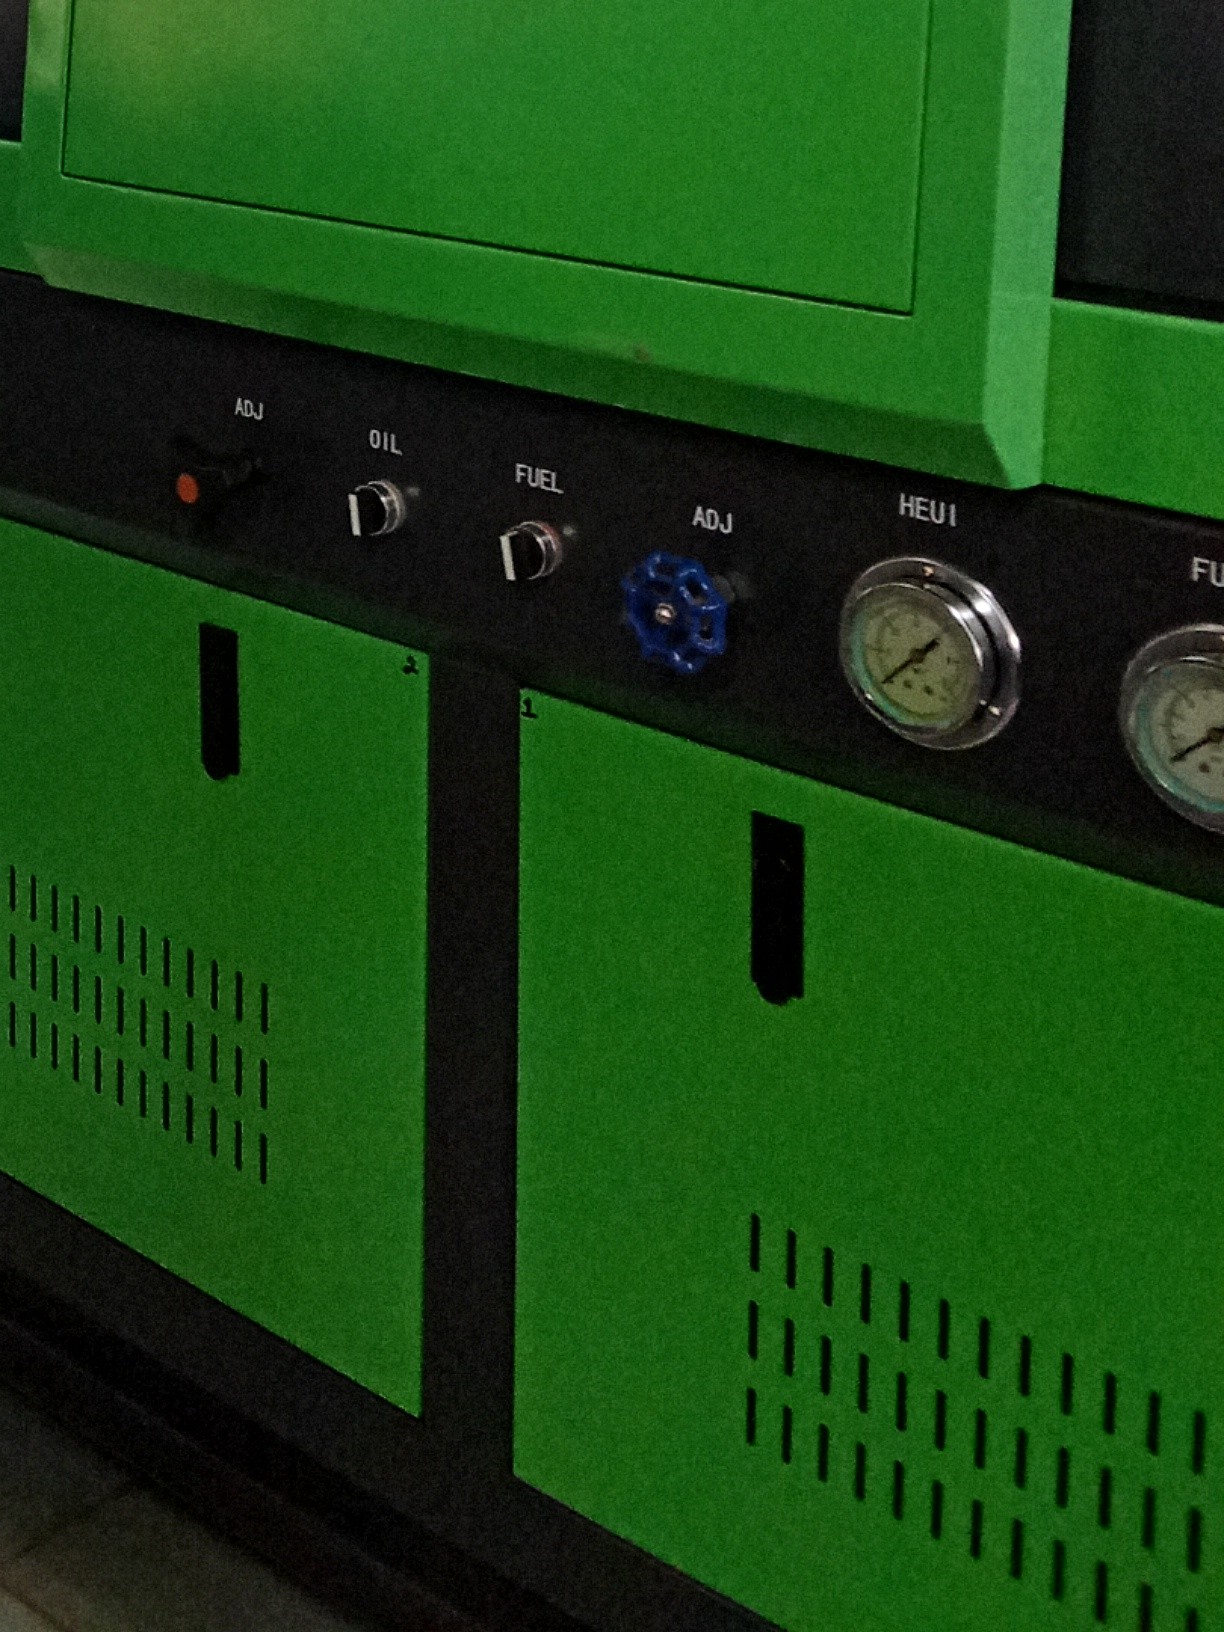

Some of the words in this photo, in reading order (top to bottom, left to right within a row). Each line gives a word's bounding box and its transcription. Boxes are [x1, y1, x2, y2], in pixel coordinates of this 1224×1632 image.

[235, 397, 264, 421] ADJ
[369, 429, 402, 456] OIL
[516, 463, 564, 495] FUEL
[692, 505, 733, 535] ADJ
[899, 492, 958, 528] HEUI
